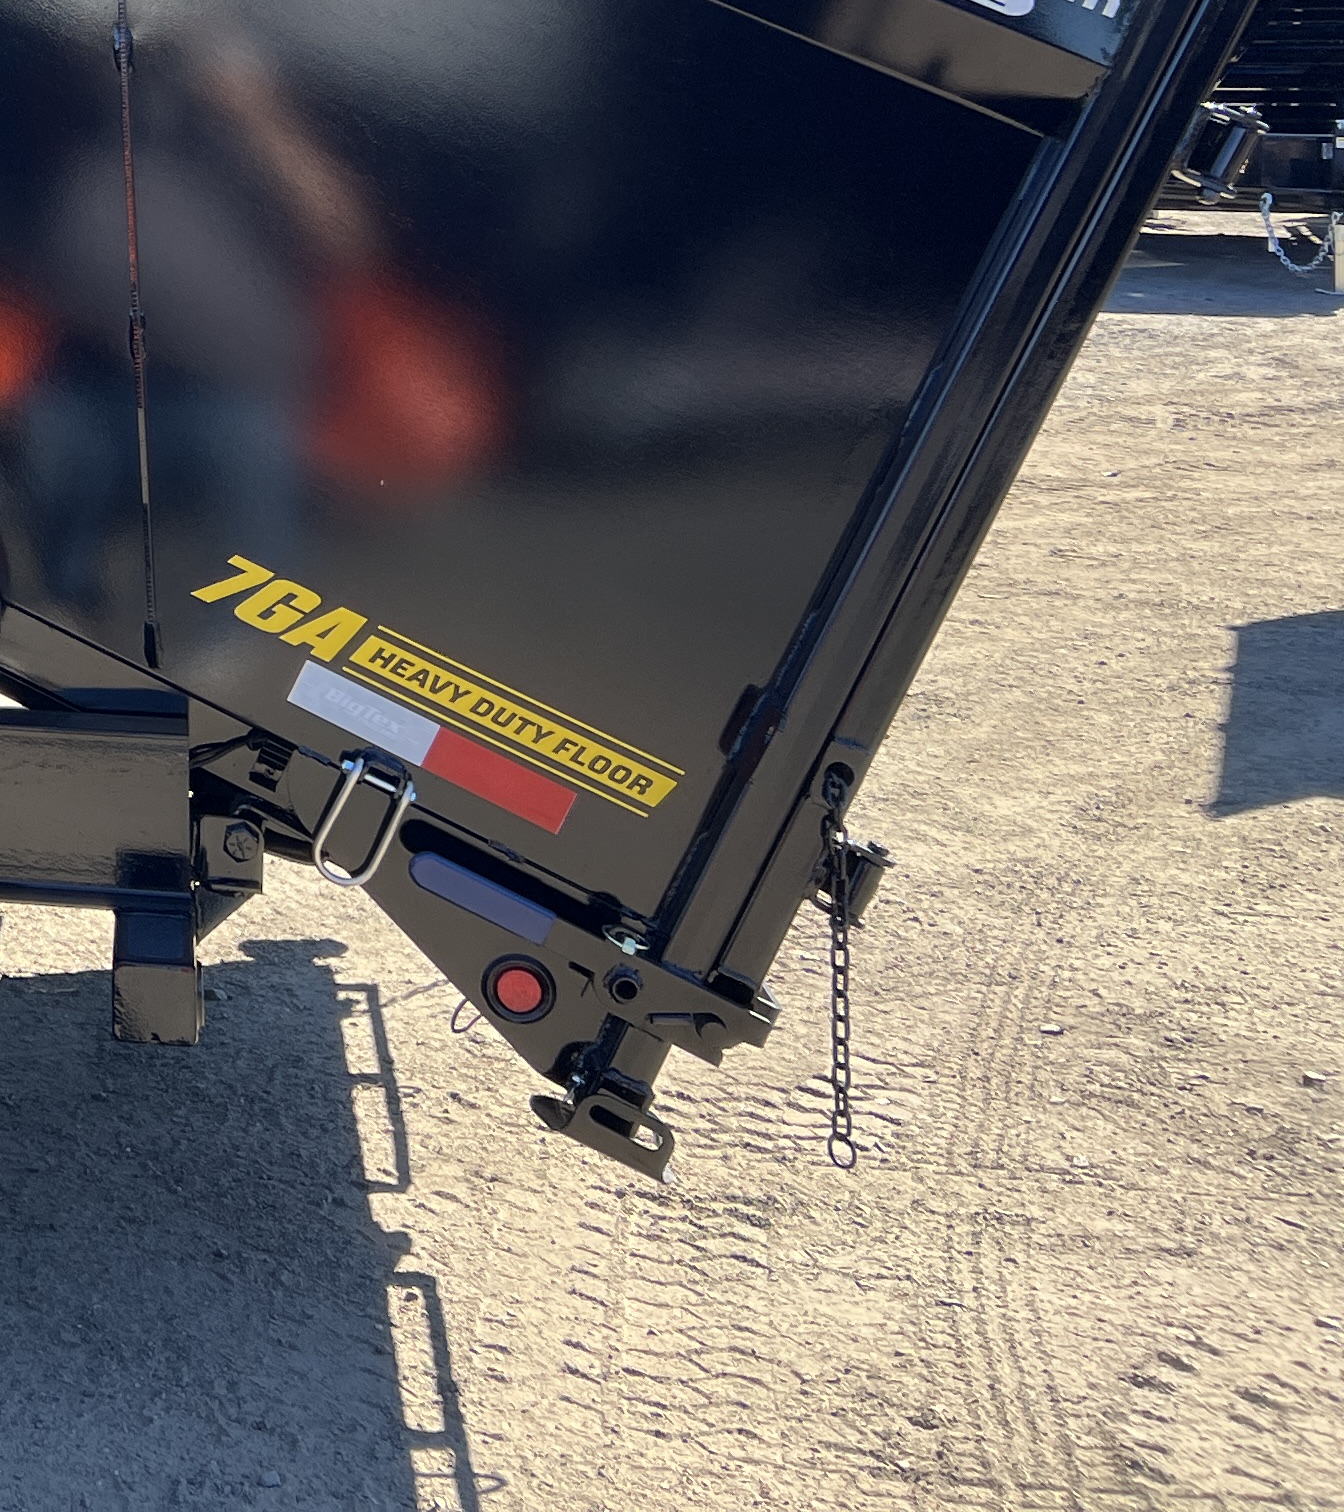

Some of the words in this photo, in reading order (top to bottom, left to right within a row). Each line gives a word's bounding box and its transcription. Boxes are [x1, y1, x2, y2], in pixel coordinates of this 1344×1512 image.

[189, 553, 369, 663] 7GA
[368, 645, 473, 705] HEAVY
[468, 695, 557, 745] DUTY
[551, 736, 655, 797] FLOOR
